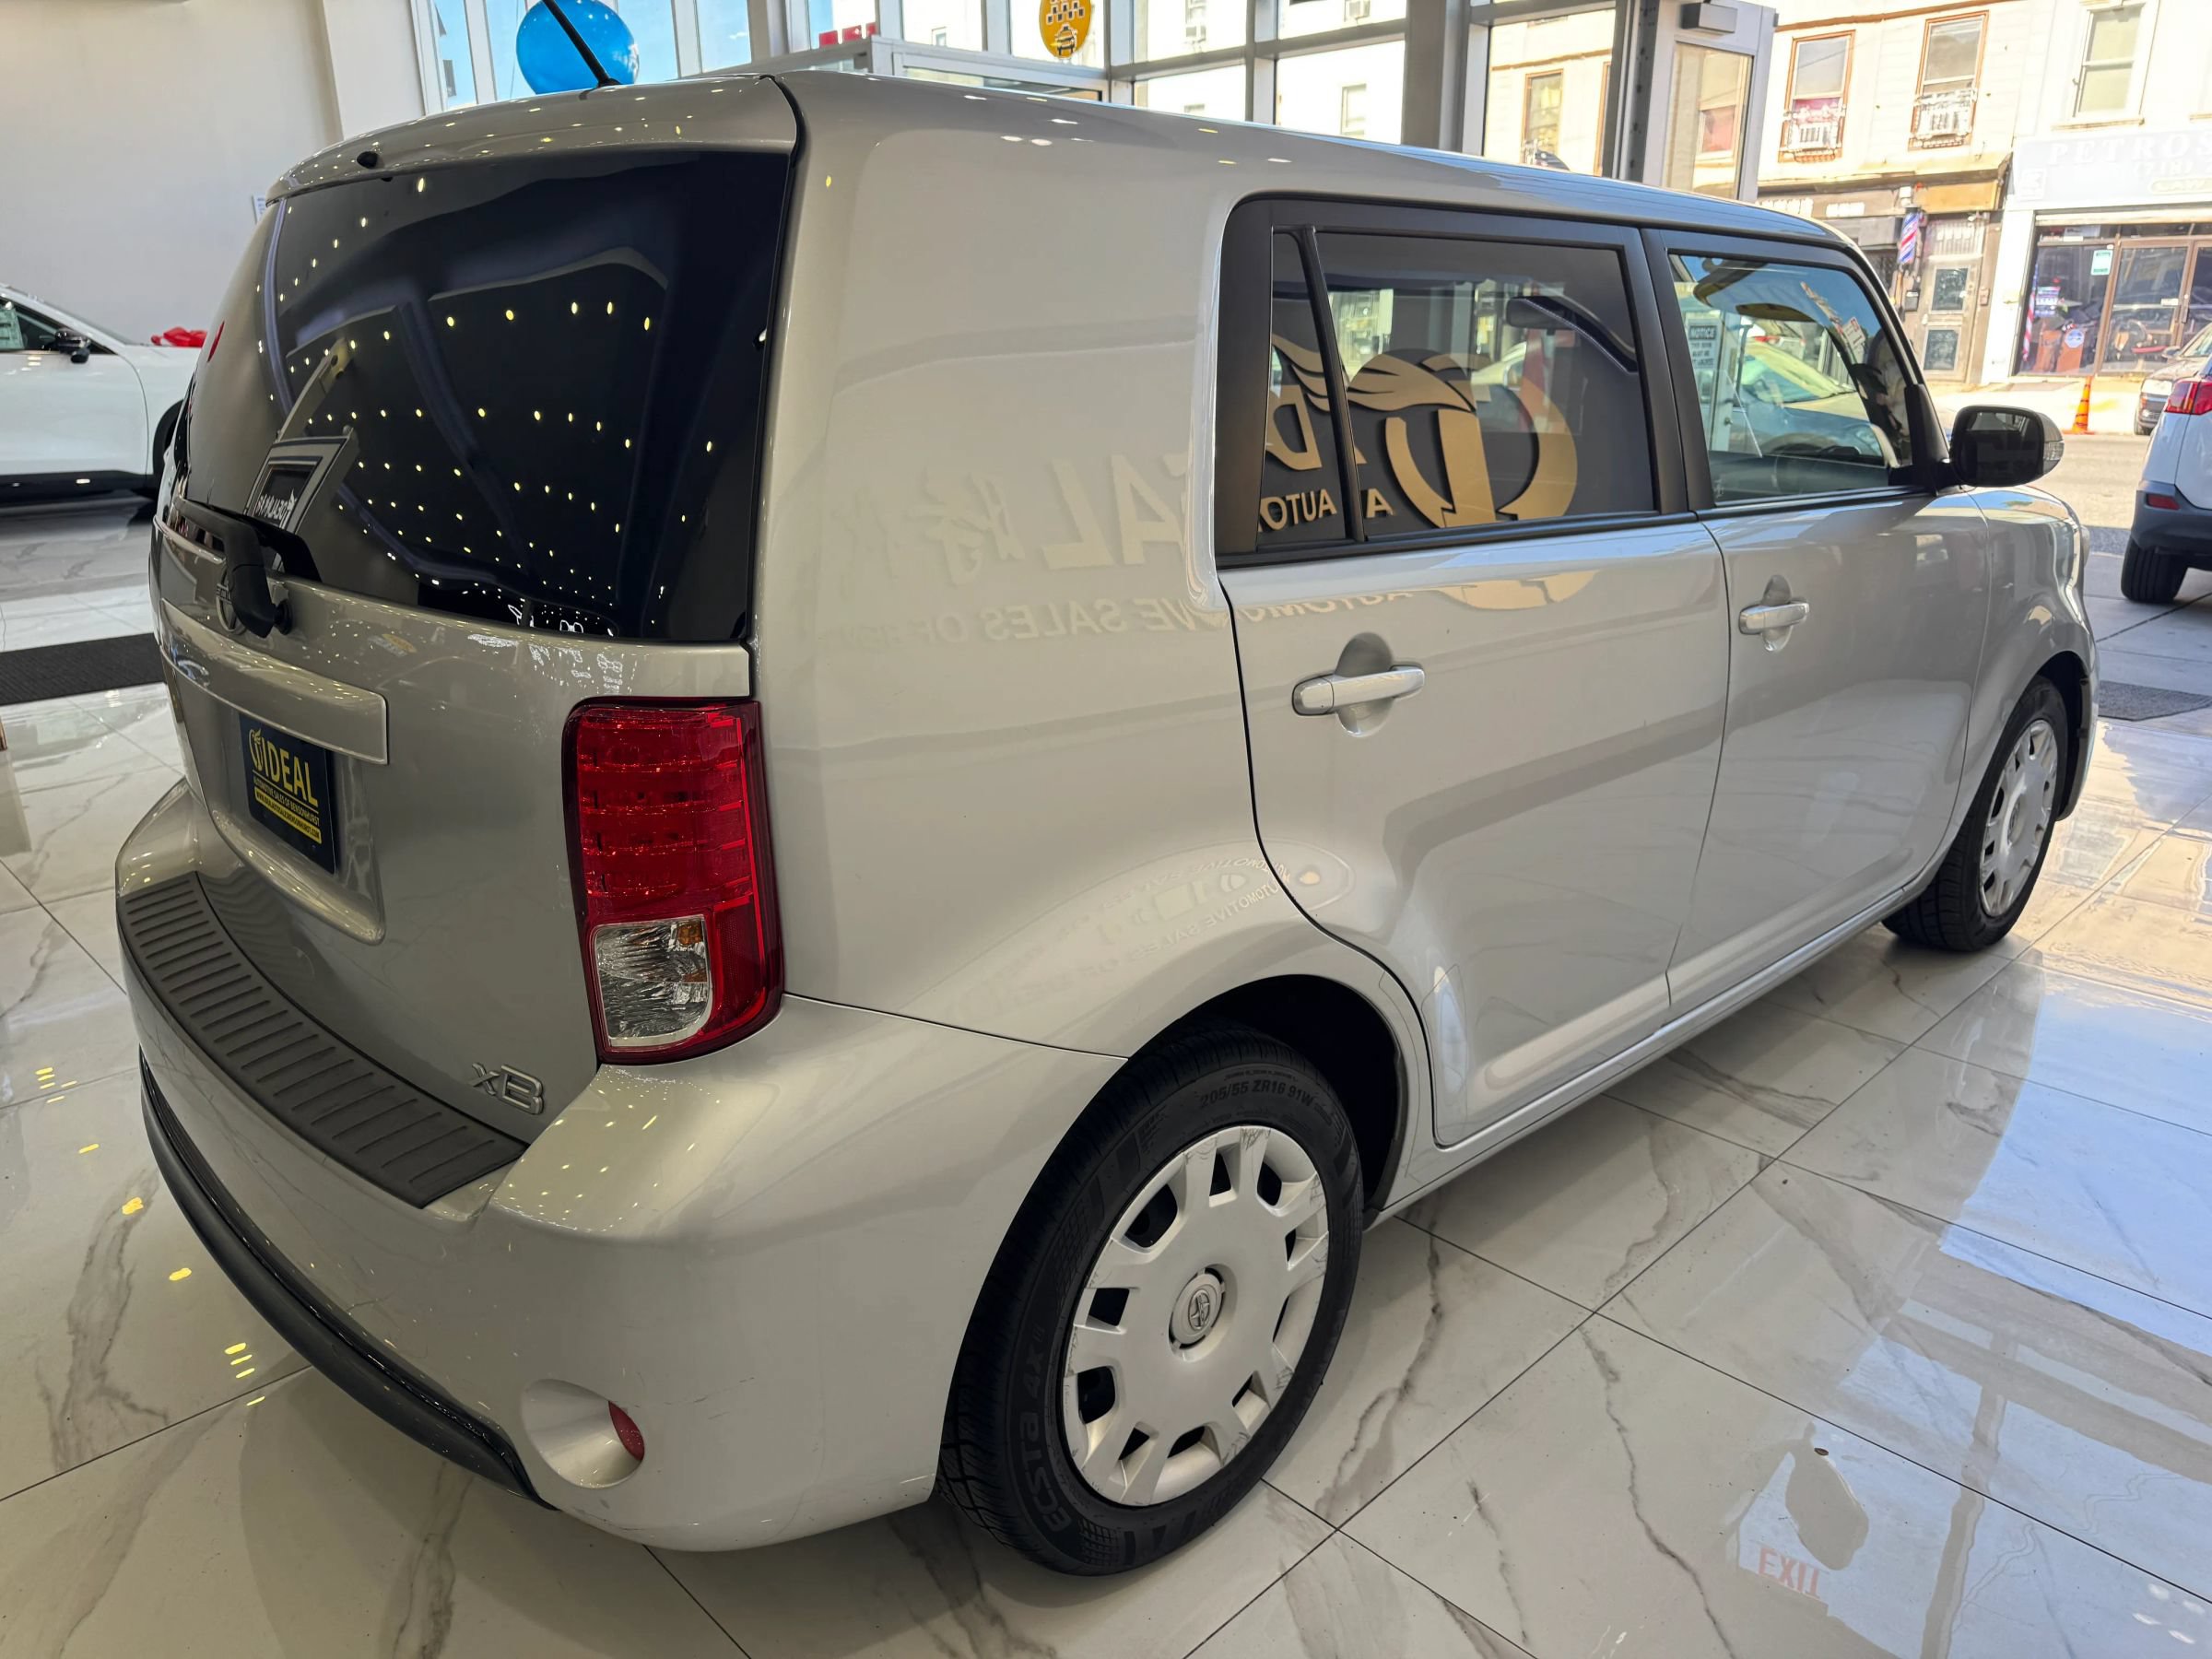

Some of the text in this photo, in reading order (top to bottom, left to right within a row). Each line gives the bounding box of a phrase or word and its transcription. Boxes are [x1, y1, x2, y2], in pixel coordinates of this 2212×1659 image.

[262, 736, 319, 807] IDEAL
[1200, 1079, 1315, 1108] 205/55 ZR16 91W
